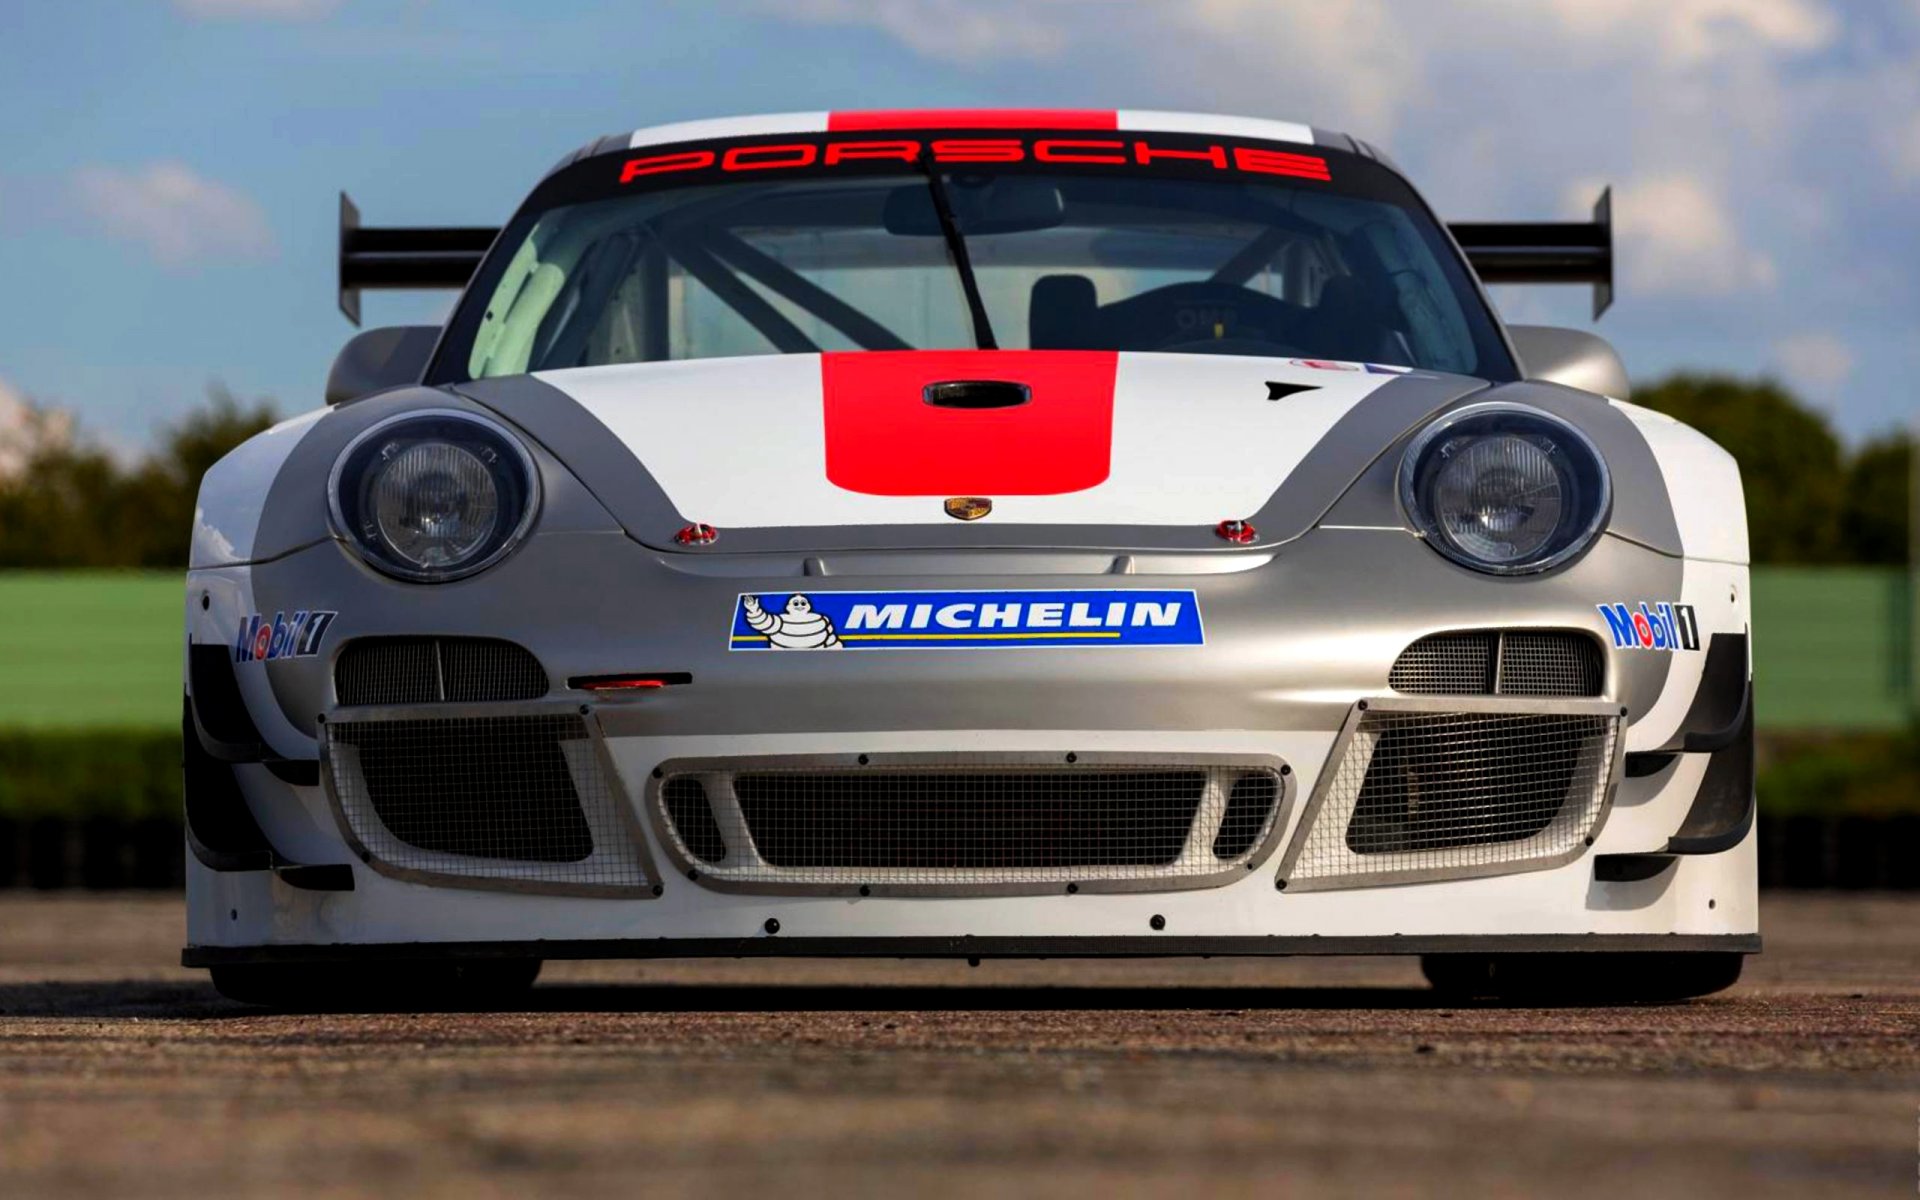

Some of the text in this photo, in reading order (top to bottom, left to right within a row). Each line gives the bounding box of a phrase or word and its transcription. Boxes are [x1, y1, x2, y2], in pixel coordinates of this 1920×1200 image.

[620, 139, 1331, 183] PORSCHE
[236, 611, 308, 662] Mobil
[844, 602, 1181, 629] MICHELIN
[1597, 603, 1679, 650] Mobil
